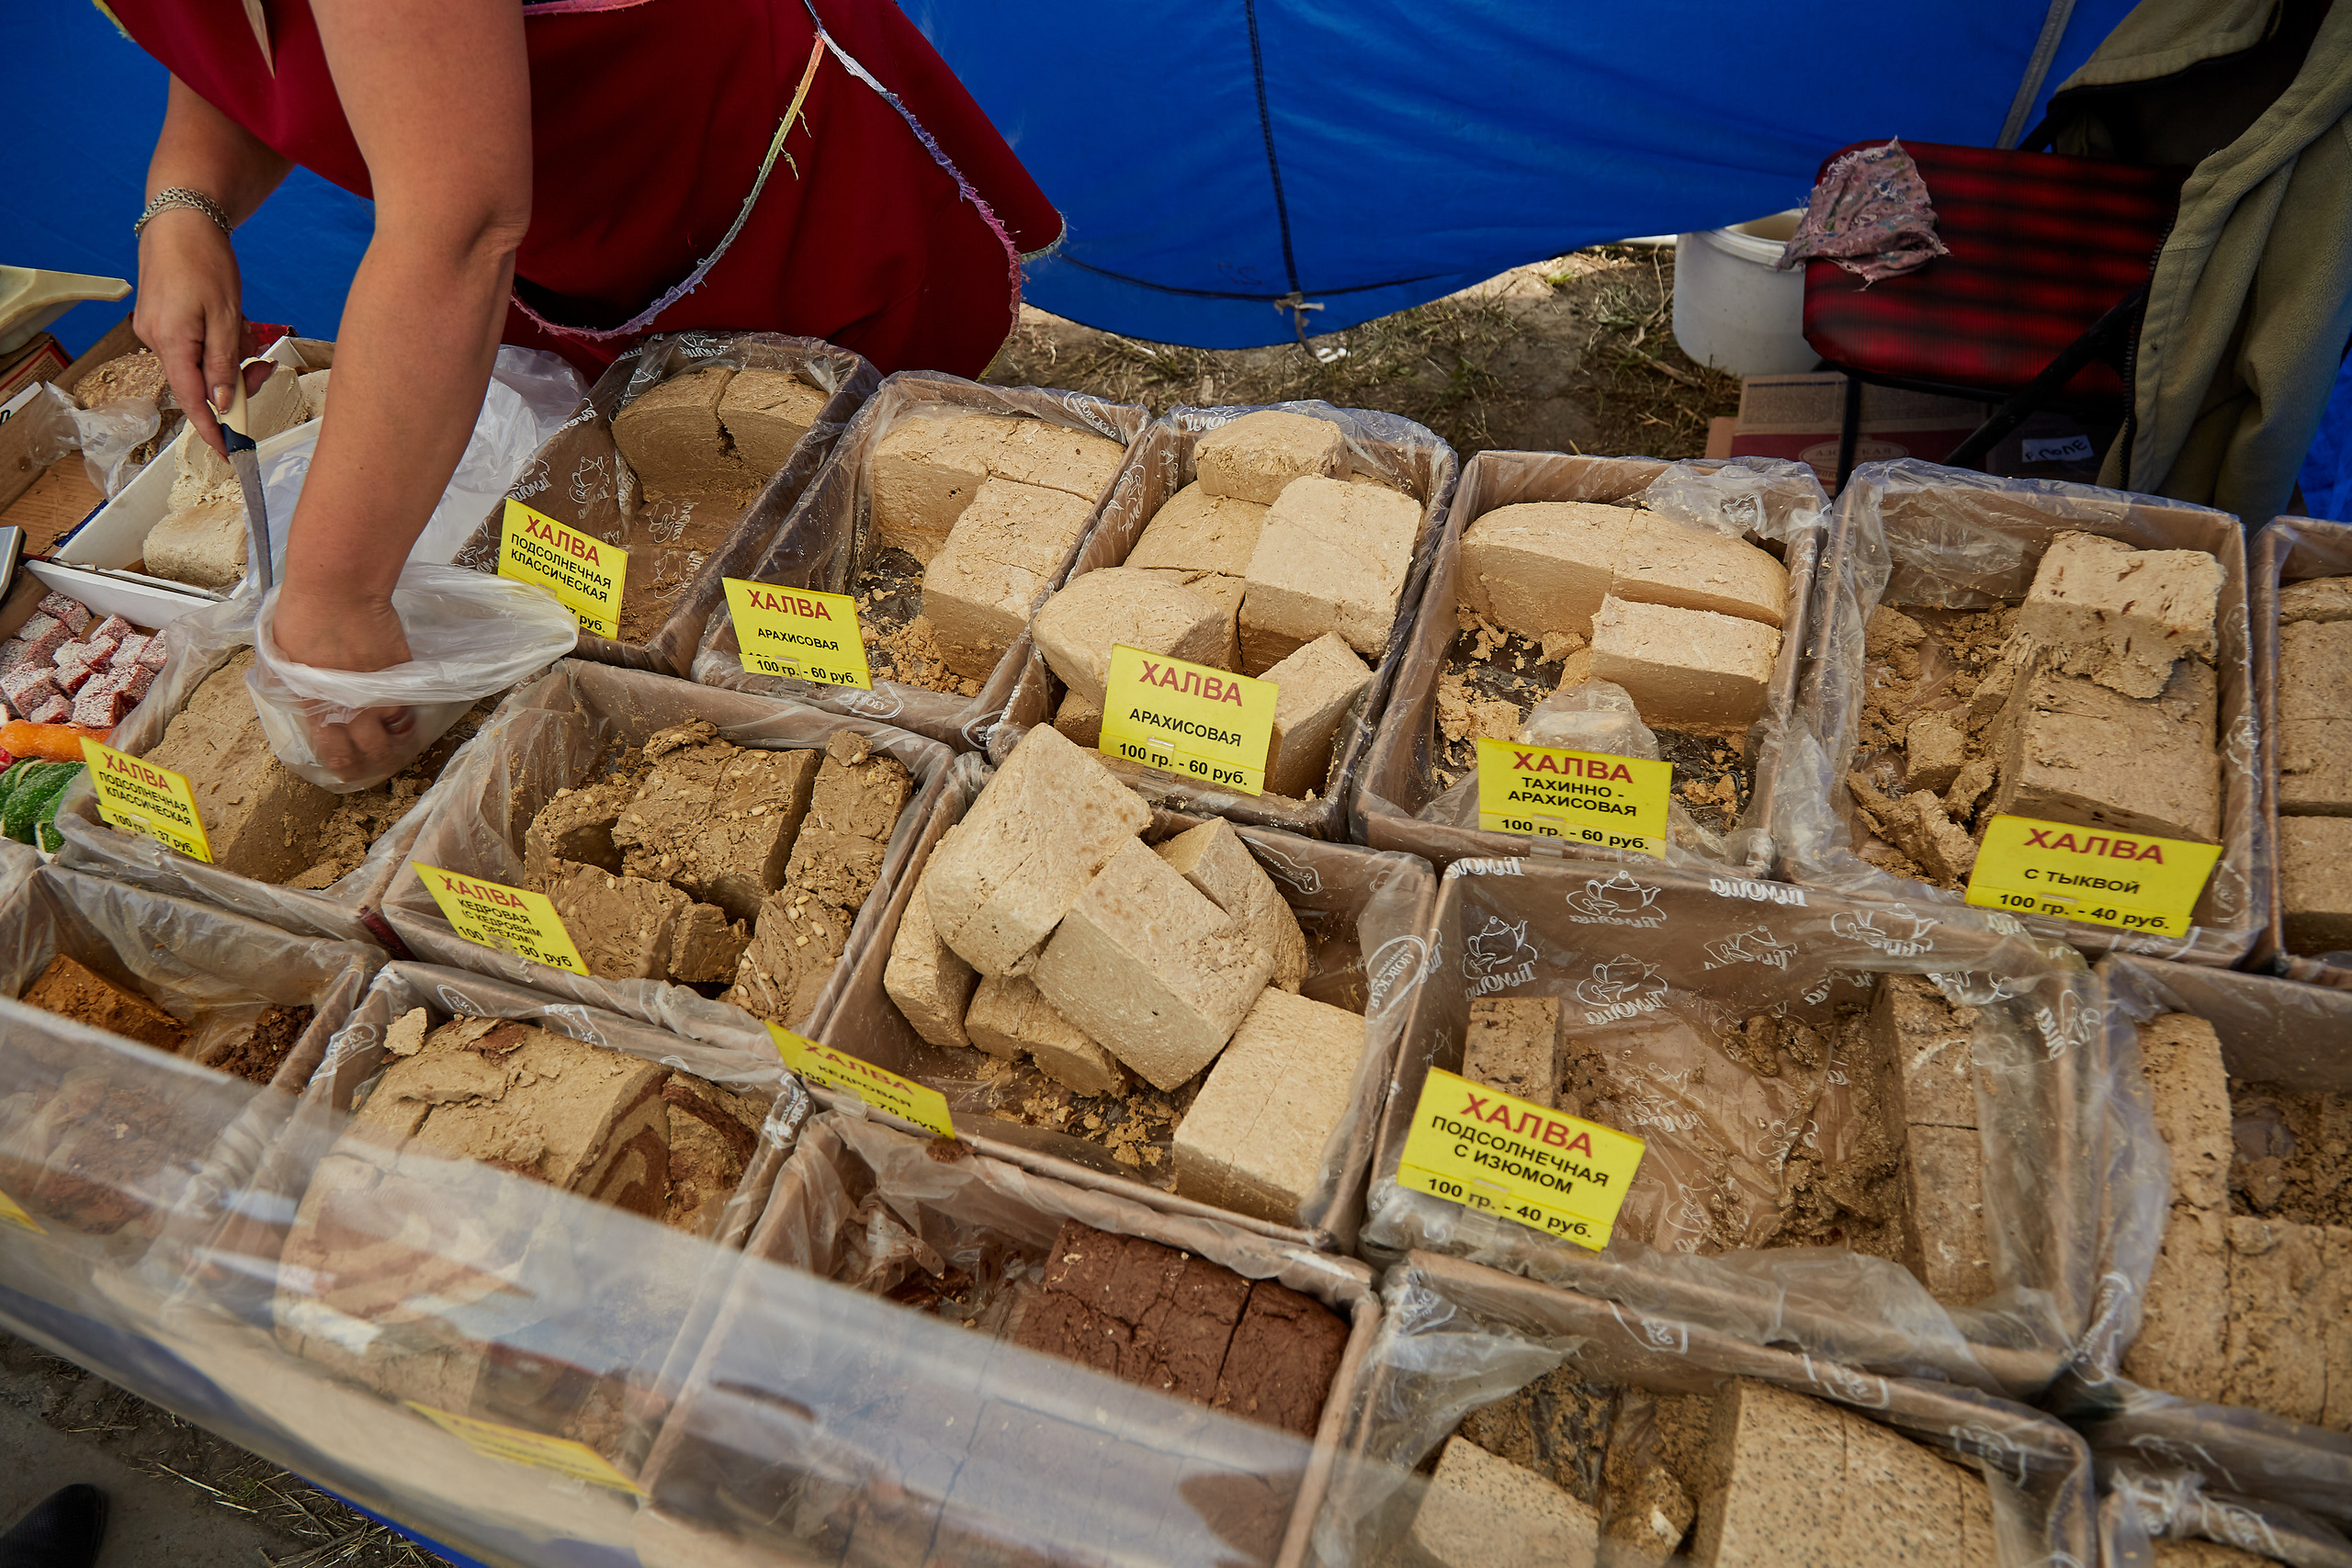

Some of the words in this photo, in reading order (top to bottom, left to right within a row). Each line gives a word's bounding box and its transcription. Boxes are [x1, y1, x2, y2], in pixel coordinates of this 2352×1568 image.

[1077, 397, 1116, 438] АЗОВСКАЯ
[526, 514, 600, 567] ХАЛВА
[511, 548, 607, 603] КЛАССИЧЕСКАЯ
[512, 534, 611, 590] ПОДСОЛНЕЧНАЯ
[580, 615, 605, 633] руб.
[747, 589, 832, 621] ХАЛВА
[758, 628, 839, 651] АРАХИСОВАЯ
[757, 660, 779, 672] 100
[782, 665, 799, 677] гр.
[810, 668, 827, 679] 60
[830, 671, 858, 684] руб.
[1139, 660, 1242, 706] ХАЛВА
[1129, 708, 1241, 747] АРАХИСОВАЯ
[102, 751, 173, 794] ХАЛВА
[1119, 743, 1147, 760] 100
[1152, 752, 1173, 767] гр.
[1189, 760, 1208, 774] 60
[1213, 768, 1248, 785] руб.
[1513, 750, 1634, 784] ХАЛВА
[98, 771, 189, 814] ПОДСОЛНЕЧНАЯ
[105, 785, 192, 828] КЛАССИЧЕСКАЯ
[1508, 791, 1636, 817] АРАХИСОВАЯ
[1521, 776, 1611, 798] ТАХИННО
[112, 814, 131, 827] 100
[157, 830, 169, 842] 37
[173, 839, 197, 854] руб.
[1501, 819, 1532, 831] 100
[1539, 826, 1564, 837] гр.
[1581, 829, 1603, 841] 60
[1610, 835, 1649, 850] руб.
[2023, 828, 2164, 864] ХАЛВА
[438, 874, 529, 911] ХАЛВА
[2024, 869, 2040, 879] С
[2047, 871, 2140, 895] ТЫКВОЙ
[457, 898, 532, 925] КЕДРОВАЯ
[461, 909, 474, 919] (С
[478, 912, 543, 938] КЕДРОВЫМ
[2000, 894, 2035, 908] 100
[2041, 903, 2069, 916] гр.
[2091, 908, 2118, 920] 40
[2123, 913, 2170, 930] руб.
[458, 926, 484, 942] 100
[520, 944, 539, 958] 90
[543, 952, 572, 967] руб
[481, 924, 535, 946] ОРЕХОМ)
[801, 1041, 914, 1095] ХАЛВА
[819, 1066, 911, 1107] КЕДРОВАЯ
[794, 1067, 826, 1085] 100
[878, 1103, 899, 1115] 70
[1460, 1092, 1592, 1158] ХАЛВА
[1431, 1116, 1610, 1188] ПОДСОЛНЕЧНАЯ
[1454, 1144, 1469, 1157] С
[1474, 1150, 1573, 1194] ИЗЮМОМ
[1429, 1179, 1463, 1197] 100
[1469, 1193, 1496, 1211] гр.
[1517, 1206, 1542, 1222] 40
[1548, 1216, 1591, 1238] руб.
